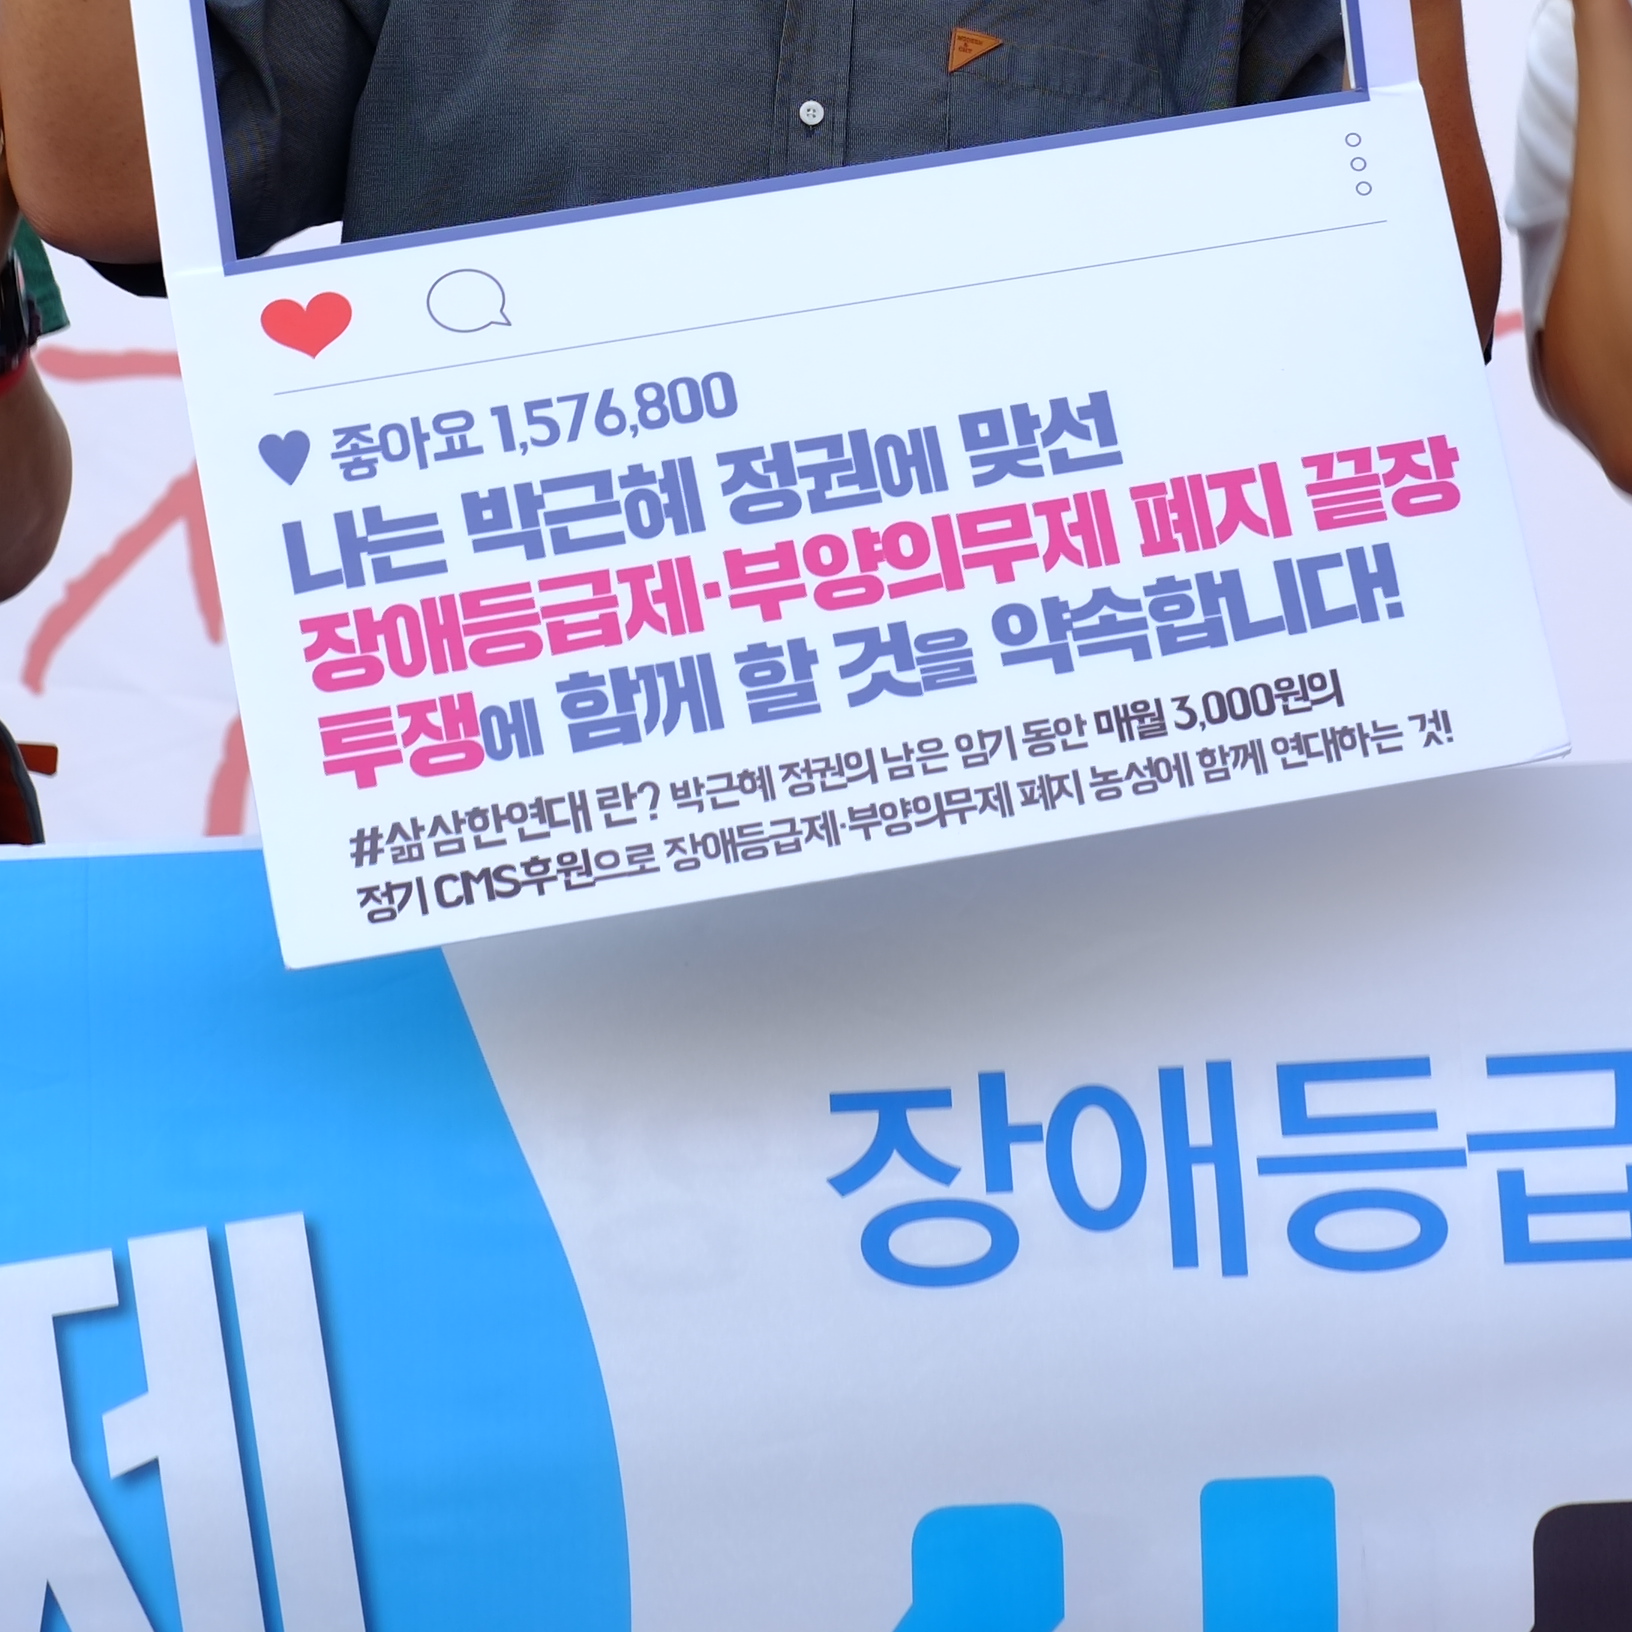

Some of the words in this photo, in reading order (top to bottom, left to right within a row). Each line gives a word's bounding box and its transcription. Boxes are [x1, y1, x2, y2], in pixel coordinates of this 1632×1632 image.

[282, 505, 448, 595] 나는
[461, 456, 706, 560] 박근혜
[716, 426, 949, 525] 정권에
[958, 390, 1123, 488] 맞선
[331, 410, 484, 481] 좋아요
[490, 372, 738, 456] 1,576,800
[299, 489, 1120, 692] 장애등급제·부양의무제
[1129, 462, 1293, 557] 폐지
[1301, 434, 1461, 531] 끝장
[318, 691, 544, 790] 투쟁에
[555, 652, 725, 753] 함께
[734, 637, 822, 724] 할
[833, 621, 978, 708] 것을
[991, 542, 1405, 675] 약속합니다!
[357, 876, 429, 924] 정기
[434, 843, 660, 908] CMS후원으로
[664, 781, 1015, 872] 장애등급제·부양의무제
[1016, 769, 1085, 811] 폐지
[1089, 751, 1194, 802] 농성에
[1196, 738, 1268, 784] 함께
[1271, 720, 1403, 770] 연대하는
[1408, 709, 1453, 748] 것!
[596, 781, 660, 828] 란?
[670, 765, 776, 813] 박근혜
[779, 748, 879, 797] 정권의
[881, 737, 949, 781] 남은
[955, 725, 1017, 769] 임기
[1022, 713, 1088, 757] 동안
[1093, 698, 1168, 743] 매월
[1171, 669, 1344, 731] 3,000원의
